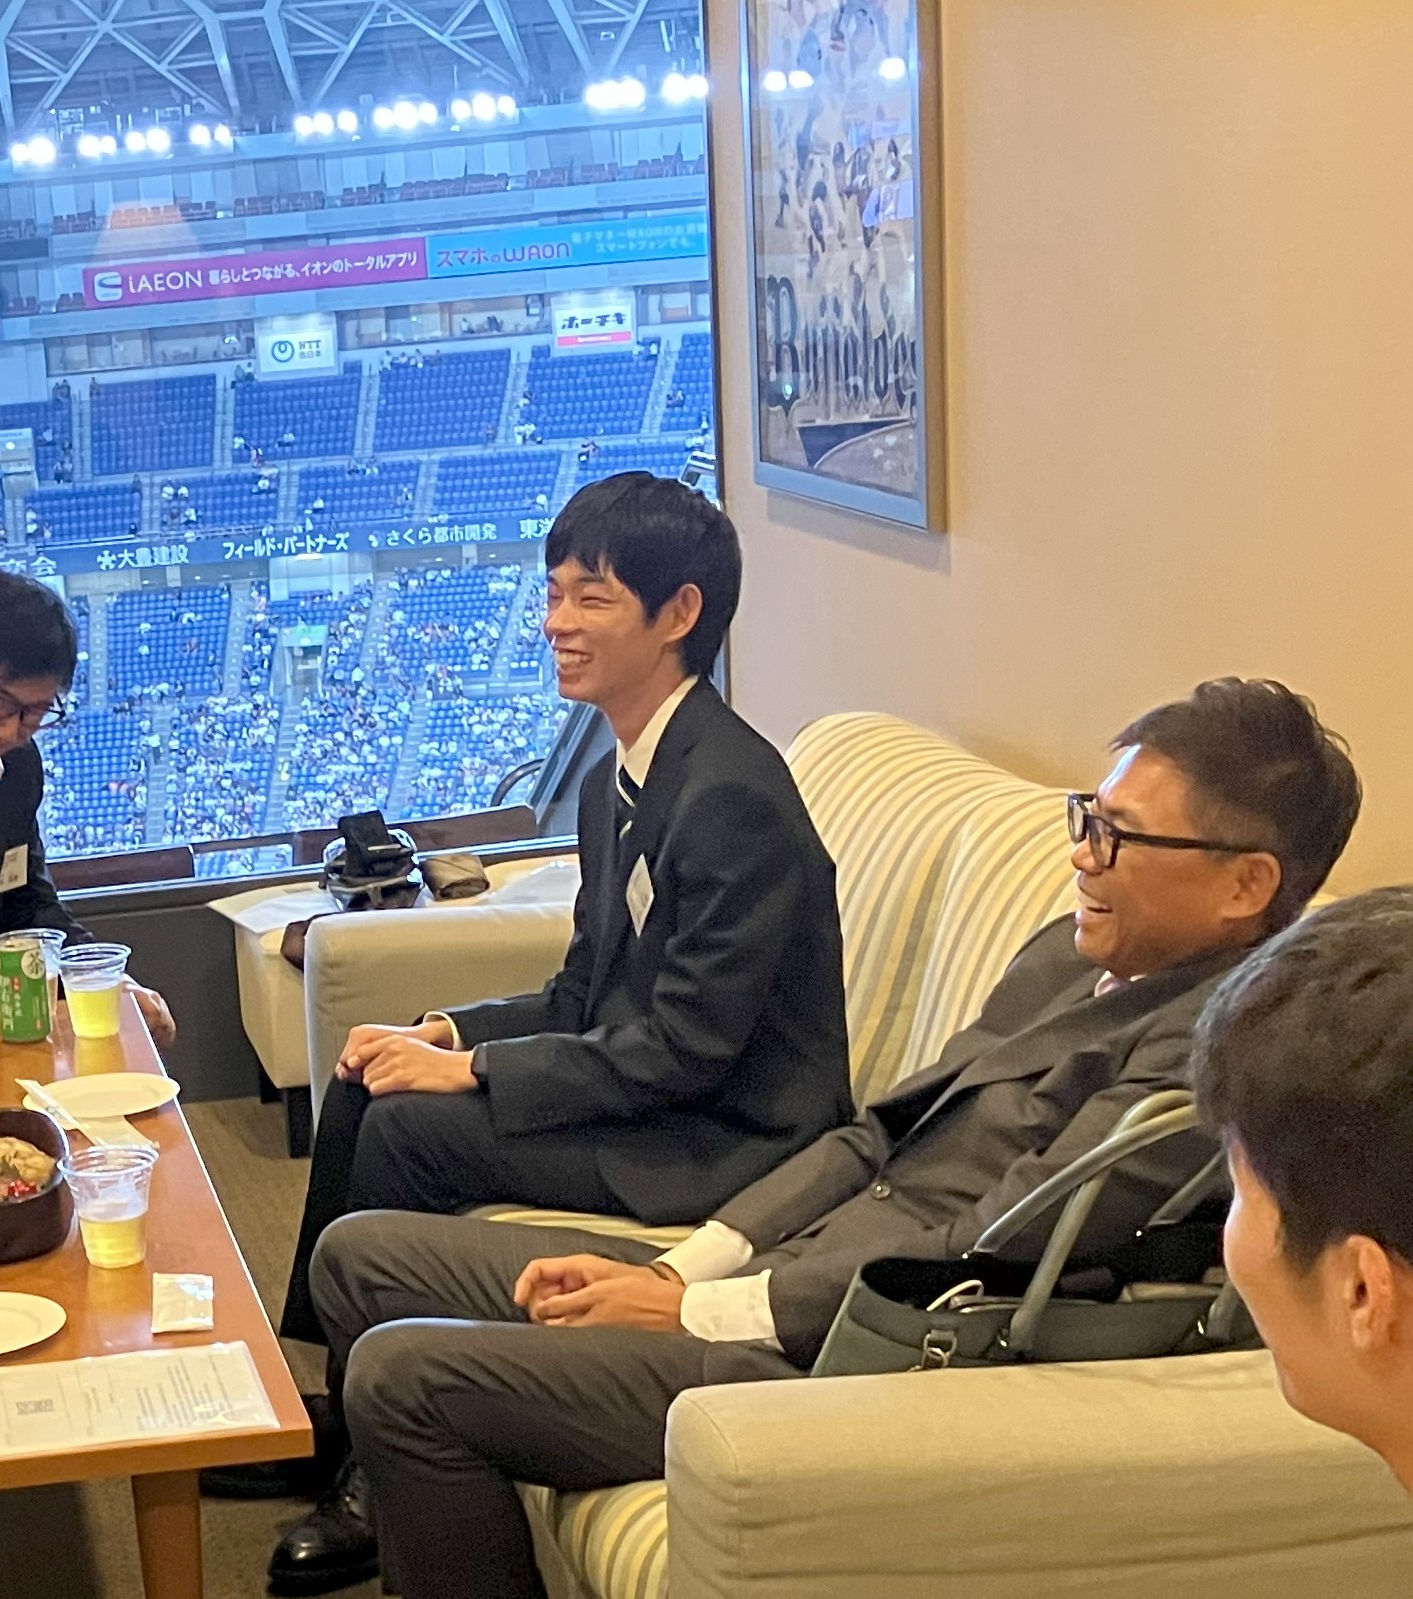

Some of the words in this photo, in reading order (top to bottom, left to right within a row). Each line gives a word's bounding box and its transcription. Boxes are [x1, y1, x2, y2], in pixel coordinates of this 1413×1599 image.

[129, 269, 203, 294] iAEON
[561, 312, 627, 330] ホーチキ
[223, 532, 349, 559] フィールド・パートナーズ
[387, 523, 497, 546] さくら都市開発
[28, 950, 44, 975] 茶
